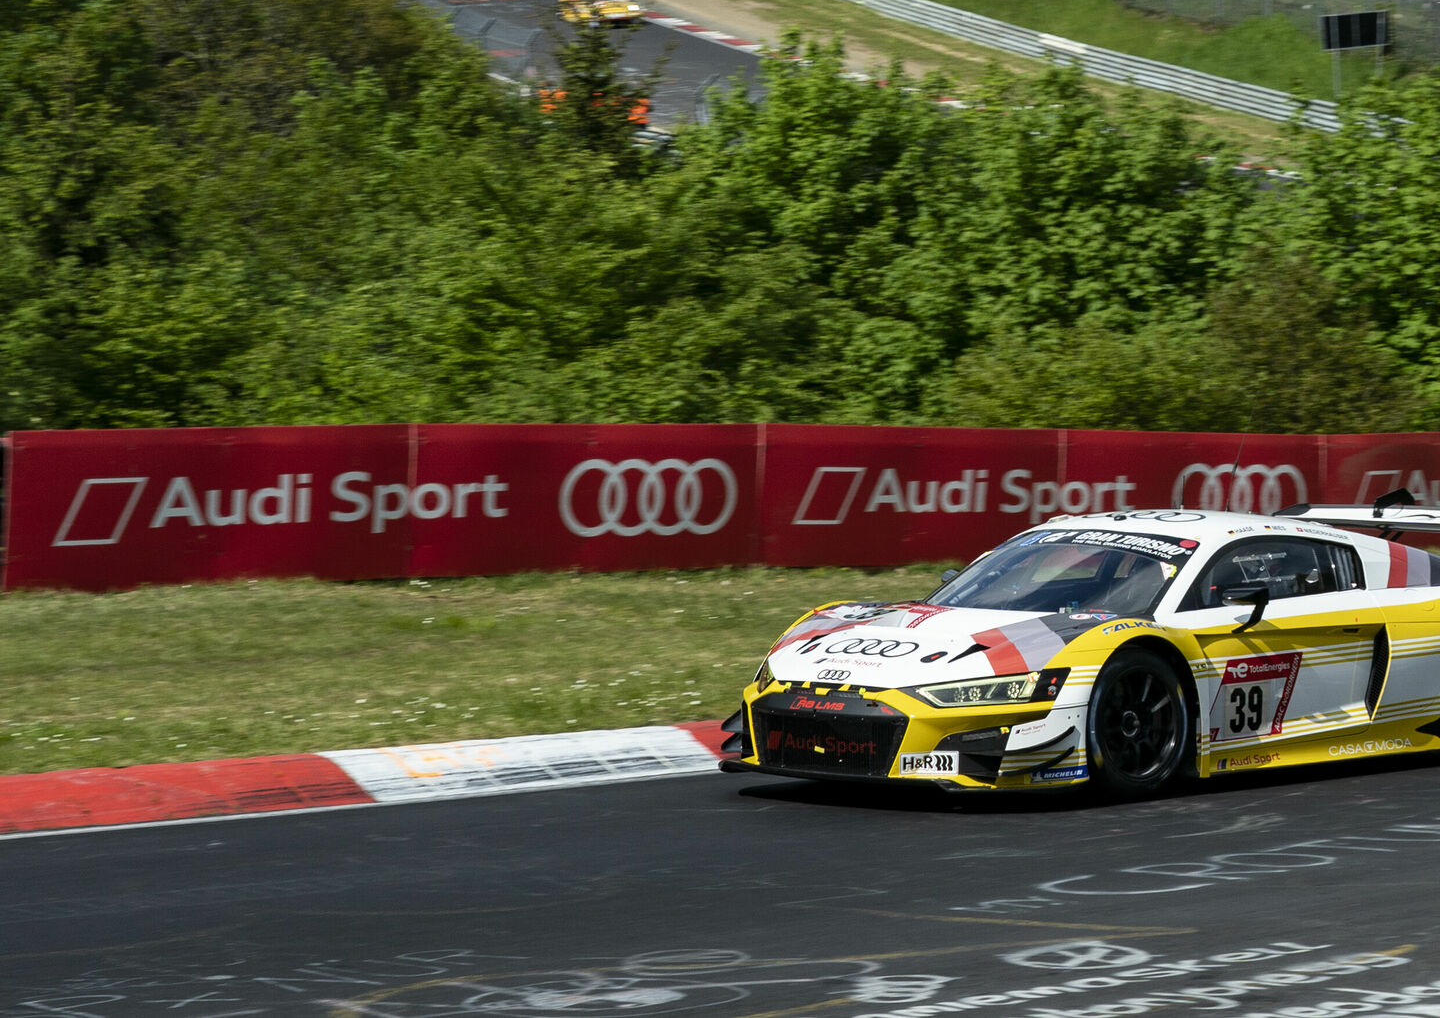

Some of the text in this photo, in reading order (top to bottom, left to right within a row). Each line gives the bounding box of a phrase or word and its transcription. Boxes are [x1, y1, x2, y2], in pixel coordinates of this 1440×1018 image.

[150, 471, 509, 534] Audi Sport
[865, 468, 1137, 525] Audi Sport
[1075, 531, 1187, 556] GRAN TURISMO
[1102, 541, 1131, 549] DRIVING
[1131, 544, 1173, 560] SIMULATOR
[1249, 662, 1291, 674] TotalEnergies
[1273, 653, 1300, 733] ADAC NORDRHEIN
[815, 701, 845, 711] LMS
[1229, 685, 1264, 734] 39
[783, 733, 877, 757] Audi Sport
[1328, 738, 1414, 757] CASA MODA
[903, 755, 934, 771] H&R
[1229, 752, 1281, 767] Audi Sport
[1043, 769, 1083, 779] MICHELIN
